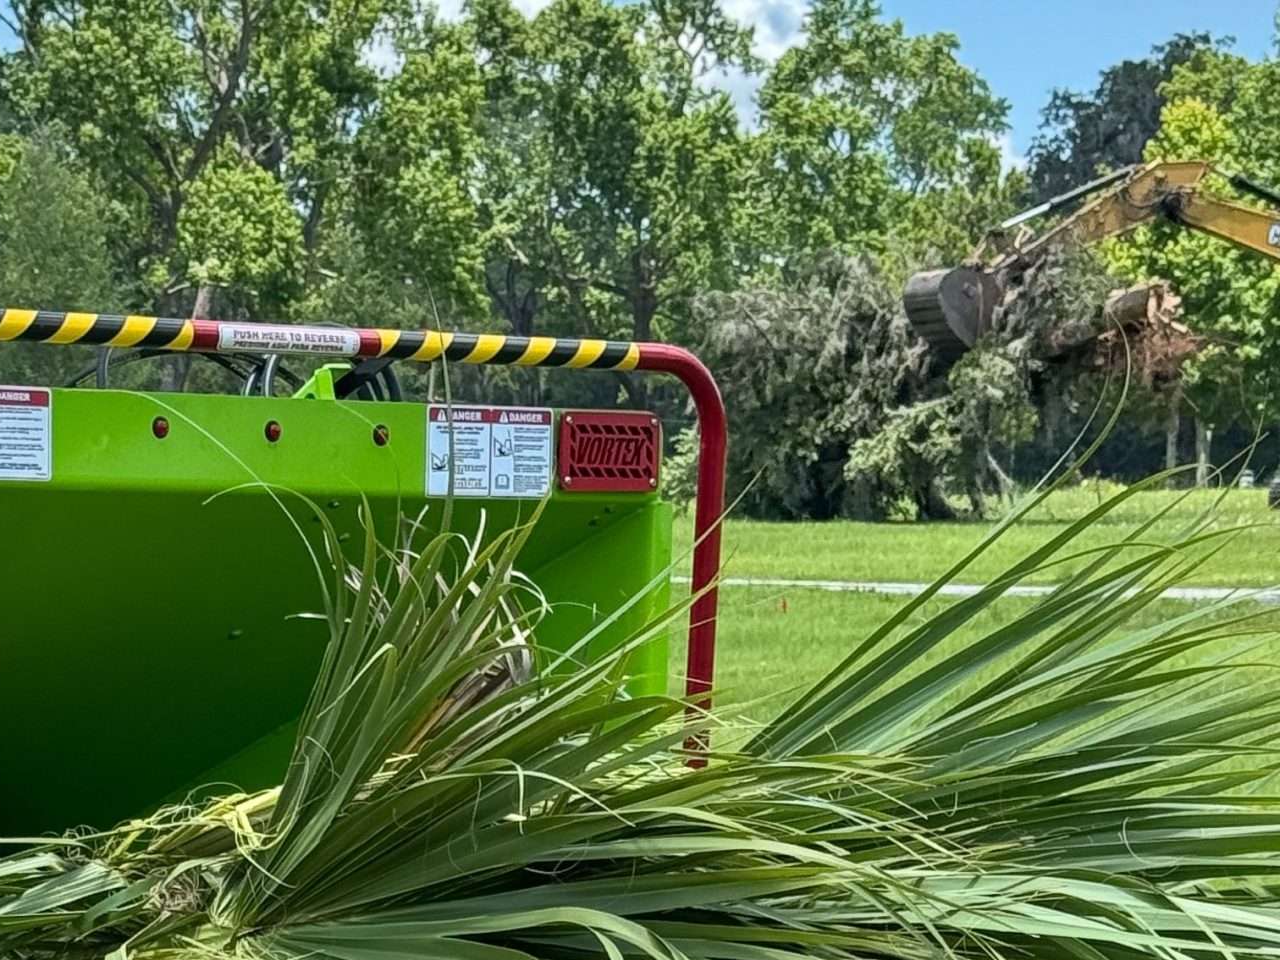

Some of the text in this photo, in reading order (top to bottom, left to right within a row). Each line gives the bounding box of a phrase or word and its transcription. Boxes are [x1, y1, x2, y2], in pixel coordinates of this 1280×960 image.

[233, 330, 347, 344] PUSH HERE TO REVERSE
[448, 411, 482, 421] ANGER
[509, 413, 543, 423] DANGER
[576, 436, 646, 466] VORTEX
